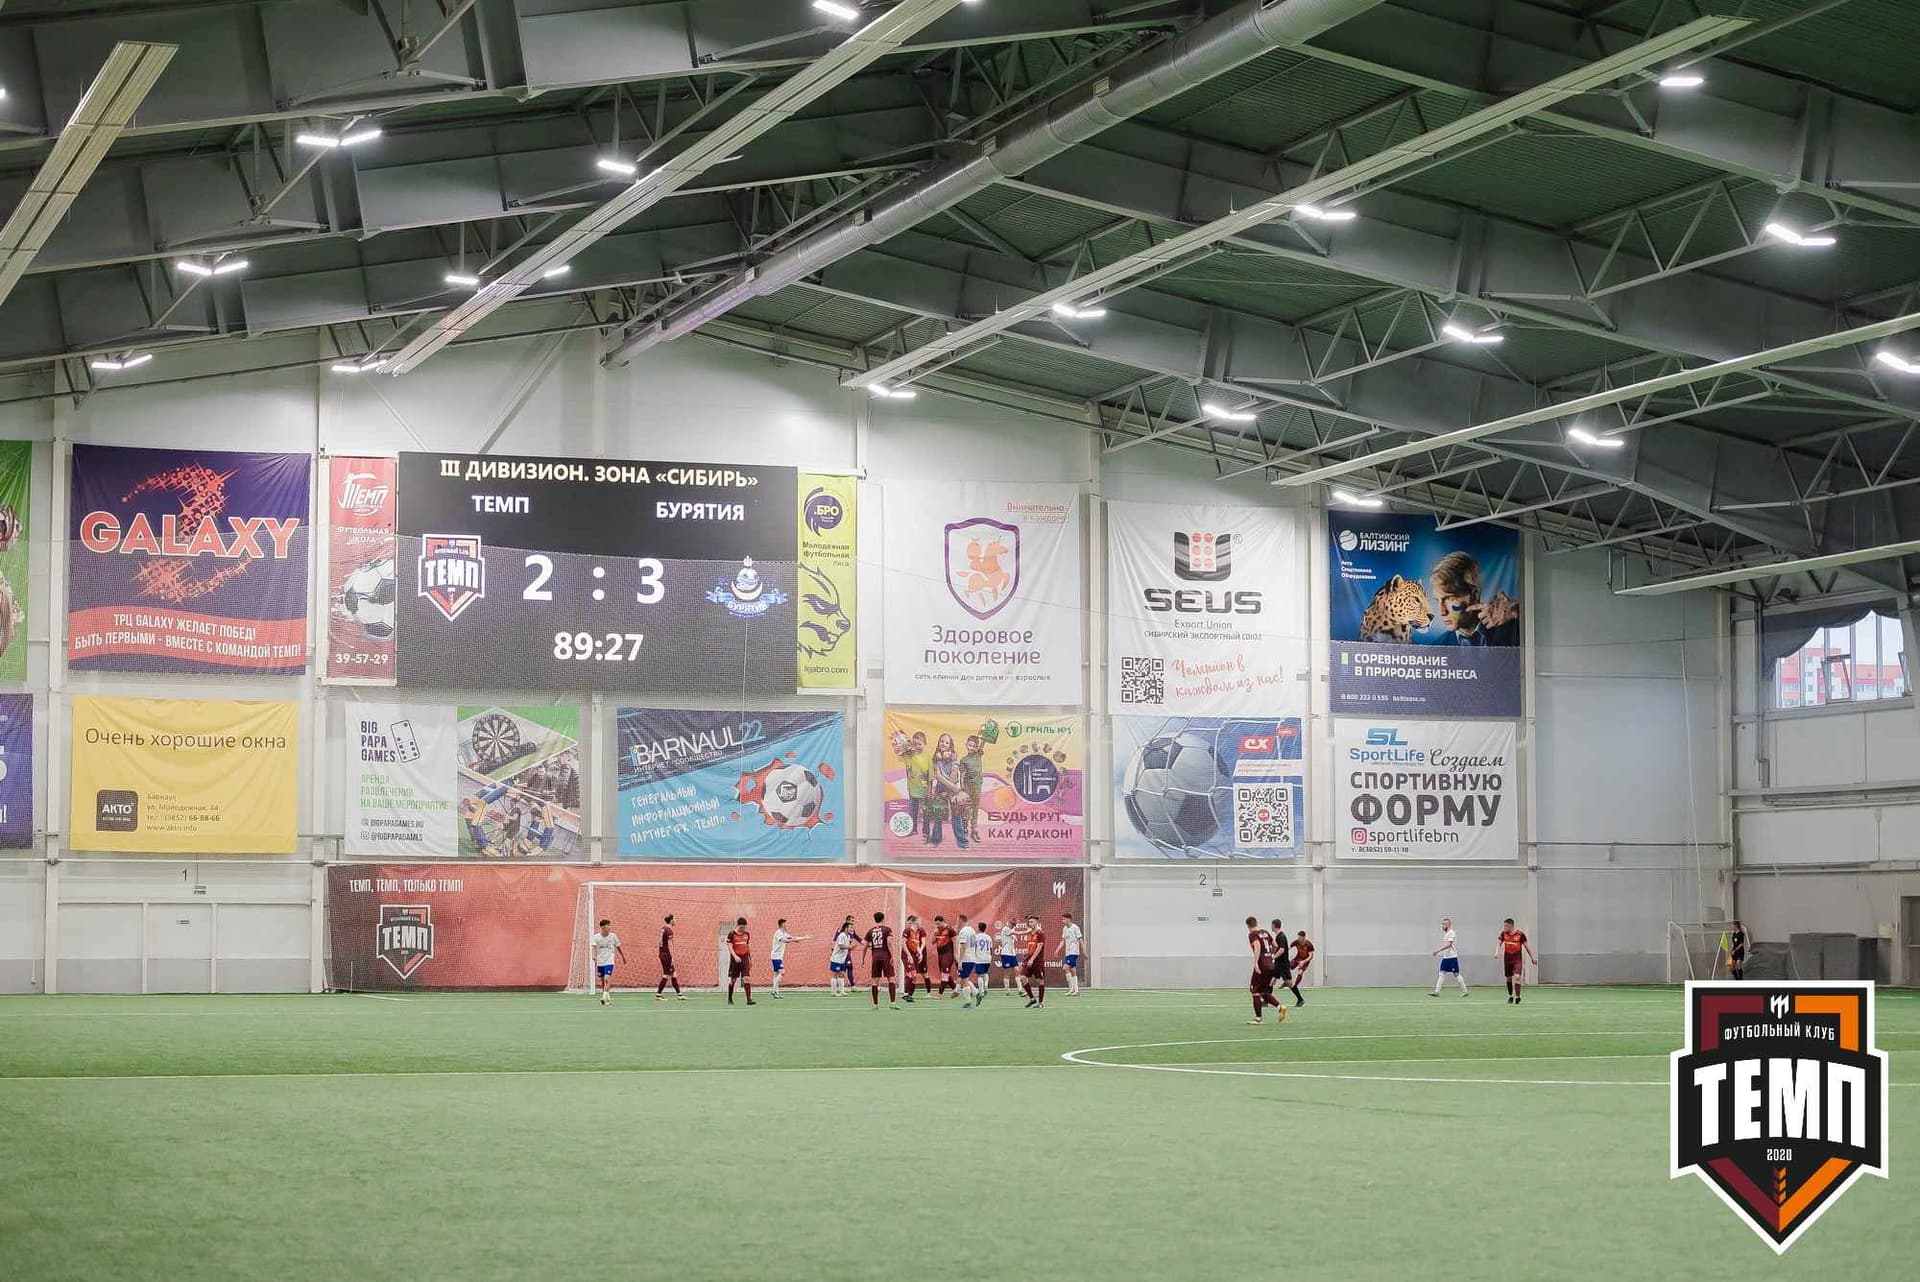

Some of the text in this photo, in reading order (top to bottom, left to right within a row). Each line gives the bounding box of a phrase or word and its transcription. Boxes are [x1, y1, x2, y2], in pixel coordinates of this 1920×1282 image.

[440, 460, 758, 488] III ДИВИЗИОН. ЗОНА «СИБИРЬ»
[472, 495, 529, 514] ТЕМП
[656, 502, 745, 521] БУРЯТИЯ
[80, 510, 300, 559] GALAXY
[1359, 532, 1410, 541] БАЛТИЙСКИЙ
[1359, 540, 1410, 552] ЛИЗИНГ
[425, 558, 479, 589] ТЕМП
[523, 554, 554, 601] 2
[636, 558, 665, 604] 3
[1144, 588, 1262, 615] SEUS
[113, 613, 256, 640] ТРЦ GALAXY ЖЕЛАЕТ ПОБЕД!
[932, 625, 1033, 646] Здоровое
[75, 632, 102, 650] БЫТЬ
[105, 632, 155, 646] ПЕРВЫМИ
[165, 636, 204, 653] ВМЕСТЕ
[215, 640, 271, 659] КОМАНДОЙ
[553, 632, 644, 661] 89:27
[335, 653, 388, 665] 39-57-29
[924, 650, 1041, 665] поколение
[1354, 653, 1448, 666] СОРЕВНОВАНИЕ
[1172, 659, 1235, 679] Чемпион
[1354, 666, 1478, 680] В ПРИРОДЕ БИЗНЕСА
[1176, 676, 1235, 698] каждом
[361, 720, 378, 734] BIG
[1026, 726, 1055, 734] ГРИЛЬ
[85, 728, 286, 750] Очень хорошие окна
[361, 735, 387, 749] PAPA
[1366, 728, 1409, 746] SL
[361, 749, 395, 763] GAMES
[1350, 748, 1425, 763] SportLife
[1430, 748, 1505, 772] Создаем
[361, 773, 390, 785] АРЕНДА
[1350, 771, 1502, 792] СПОРТИВНУЮ
[631, 784, 697, 808] ГЕНЕРАЛЬНЫЙ
[102, 804, 132, 814] АКТО
[631, 796, 721, 827] ИНФОРМАЦИОННЫЙ
[988, 811, 1066, 824] БУДЬ КРУТ,
[1350, 793, 1502, 827] ФОРМУ
[630, 825, 673, 846] ПАРТНЕР
[988, 829, 1072, 841] КАК ДРАКОН!
[1369, 829, 1459, 845] sportlifebrn
[349, 879, 464, 894] ТЕМП, ТЕМП, ТОЛЬКО ТЕМП!
[1199, 873, 1207, 886] 2
[382, 925, 428, 951] ТЕМП
[871, 931, 884, 946] 22
[978, 939, 990, 952] 91
